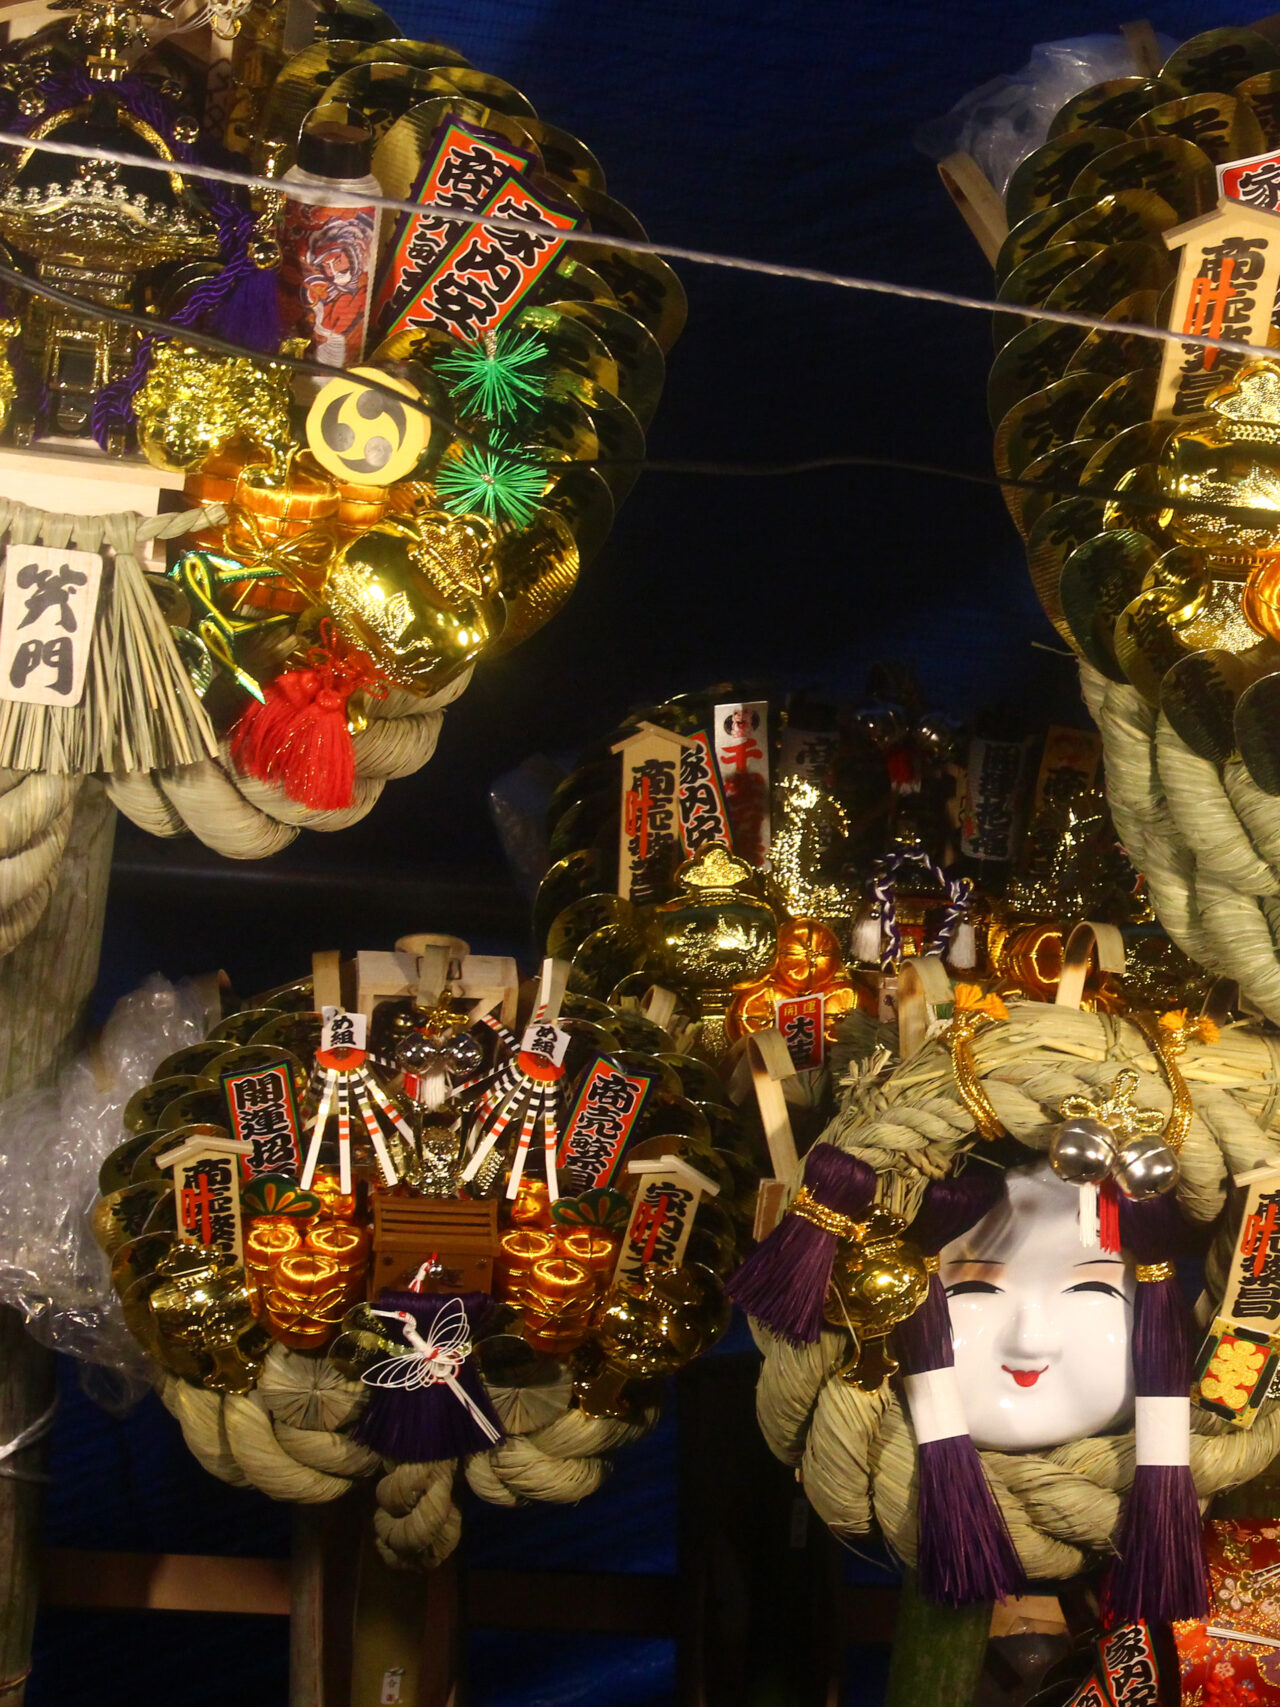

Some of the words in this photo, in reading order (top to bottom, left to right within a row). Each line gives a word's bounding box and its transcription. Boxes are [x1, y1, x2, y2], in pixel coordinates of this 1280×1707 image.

[392, 147, 508, 304] 商売
[405, 196, 557, 340] 家内安
[9, 562, 88, 697] 笑門
[330, 1015, 357, 1046] め組
[531, 1026, 558, 1059] め組
[784, 1001, 816, 1017] 開運
[235, 1073, 297, 1178] 開運招
